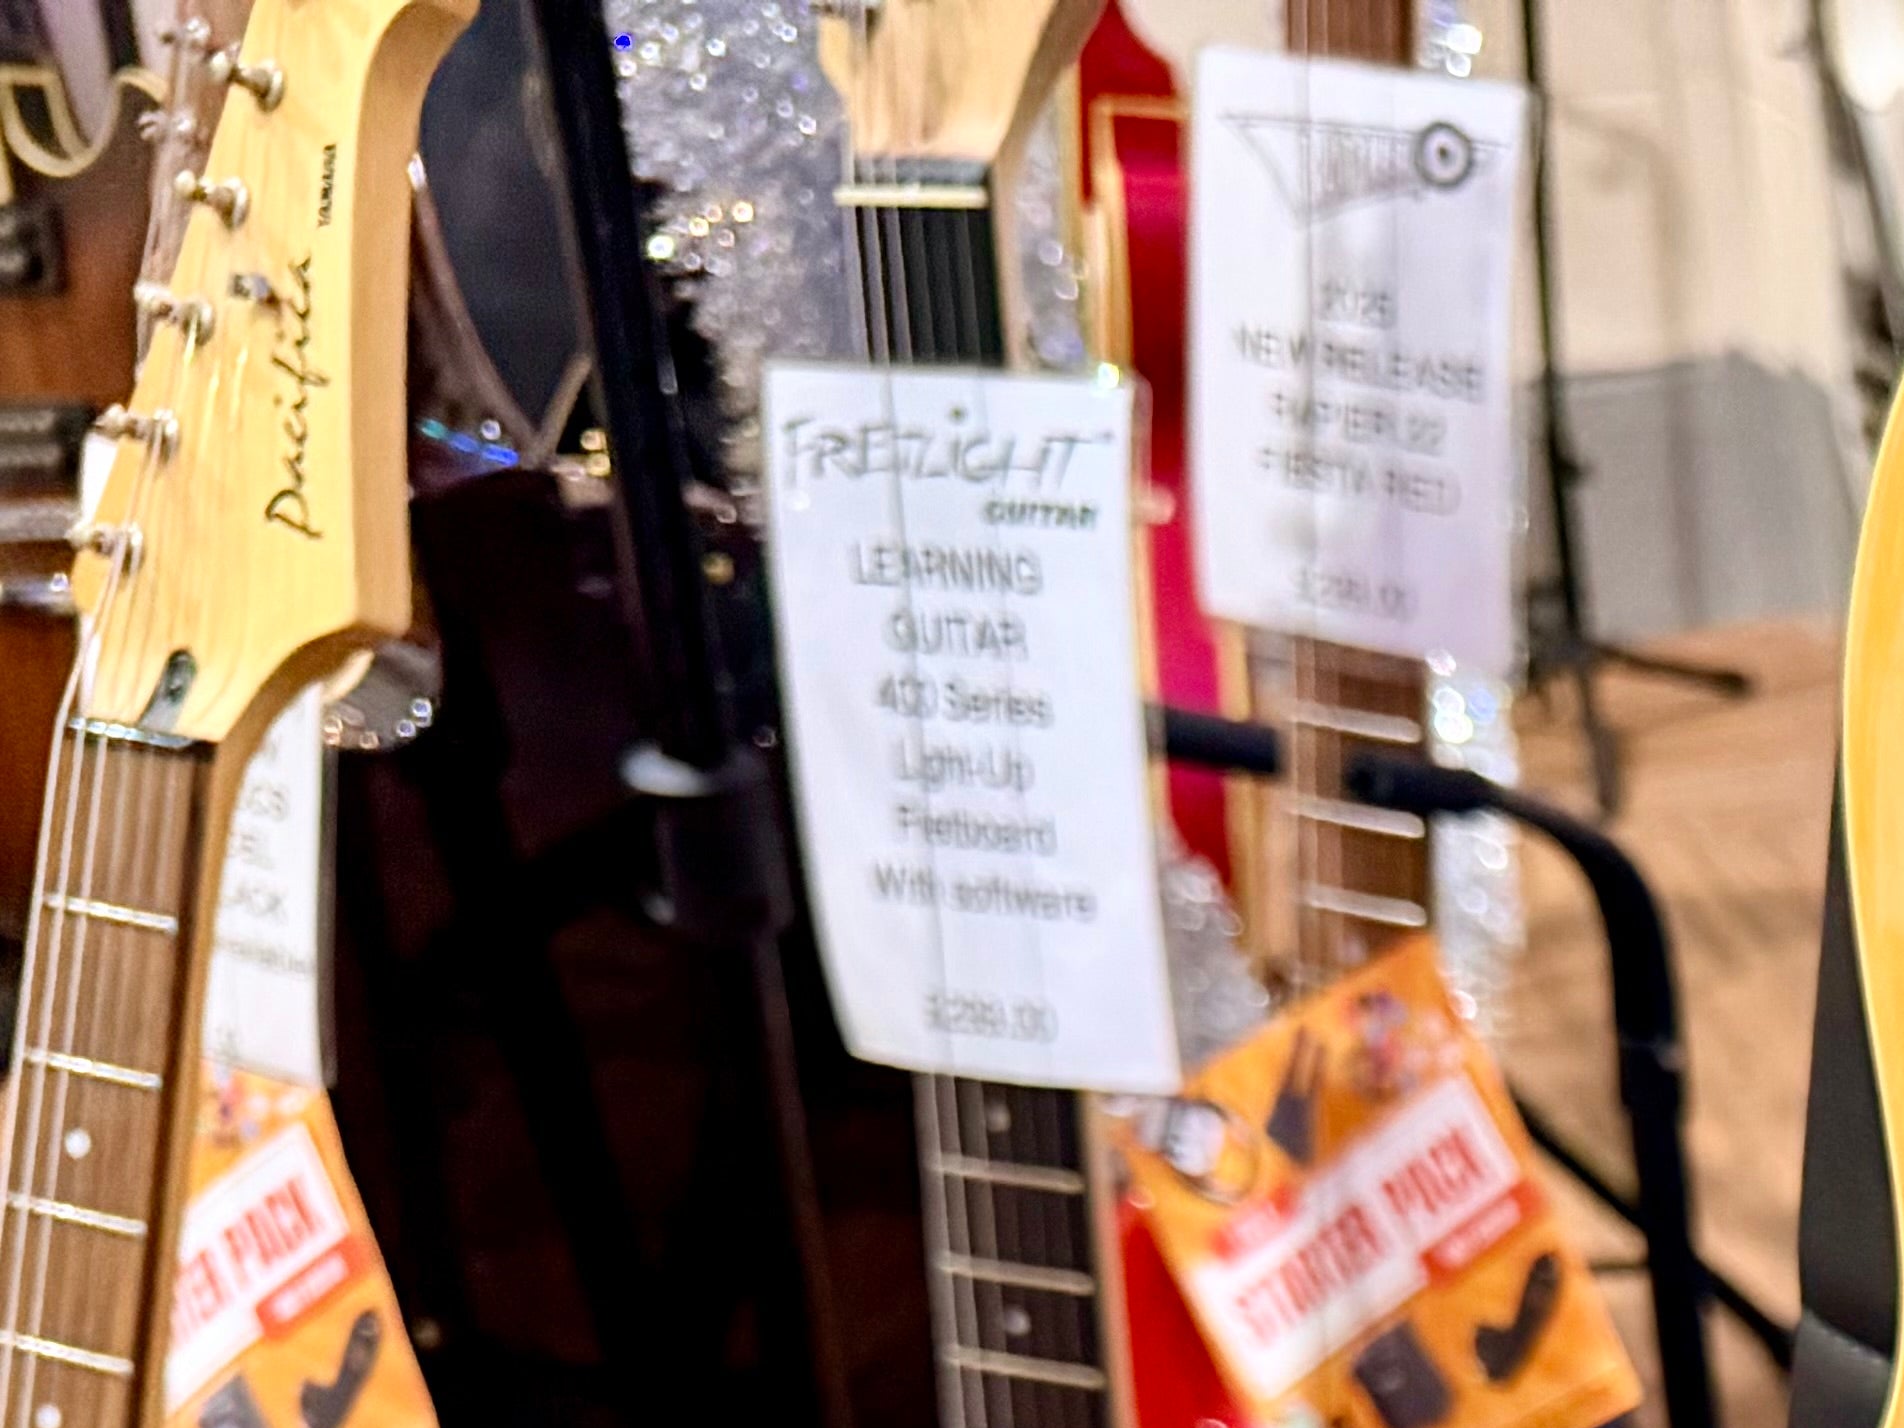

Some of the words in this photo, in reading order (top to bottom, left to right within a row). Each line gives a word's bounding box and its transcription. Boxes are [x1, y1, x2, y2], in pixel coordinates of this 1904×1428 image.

[264, 255, 331, 541] Pacifica
[853, 546, 1044, 596] LEARNING
[881, 610, 1030, 662] GUITAR
[943, 680, 1055, 730] Series
[872, 862, 946, 908] With
[950, 876, 1099, 925] software
[1378, 1127, 1488, 1236] PACK
[222, 1172, 322, 1289] PACK
